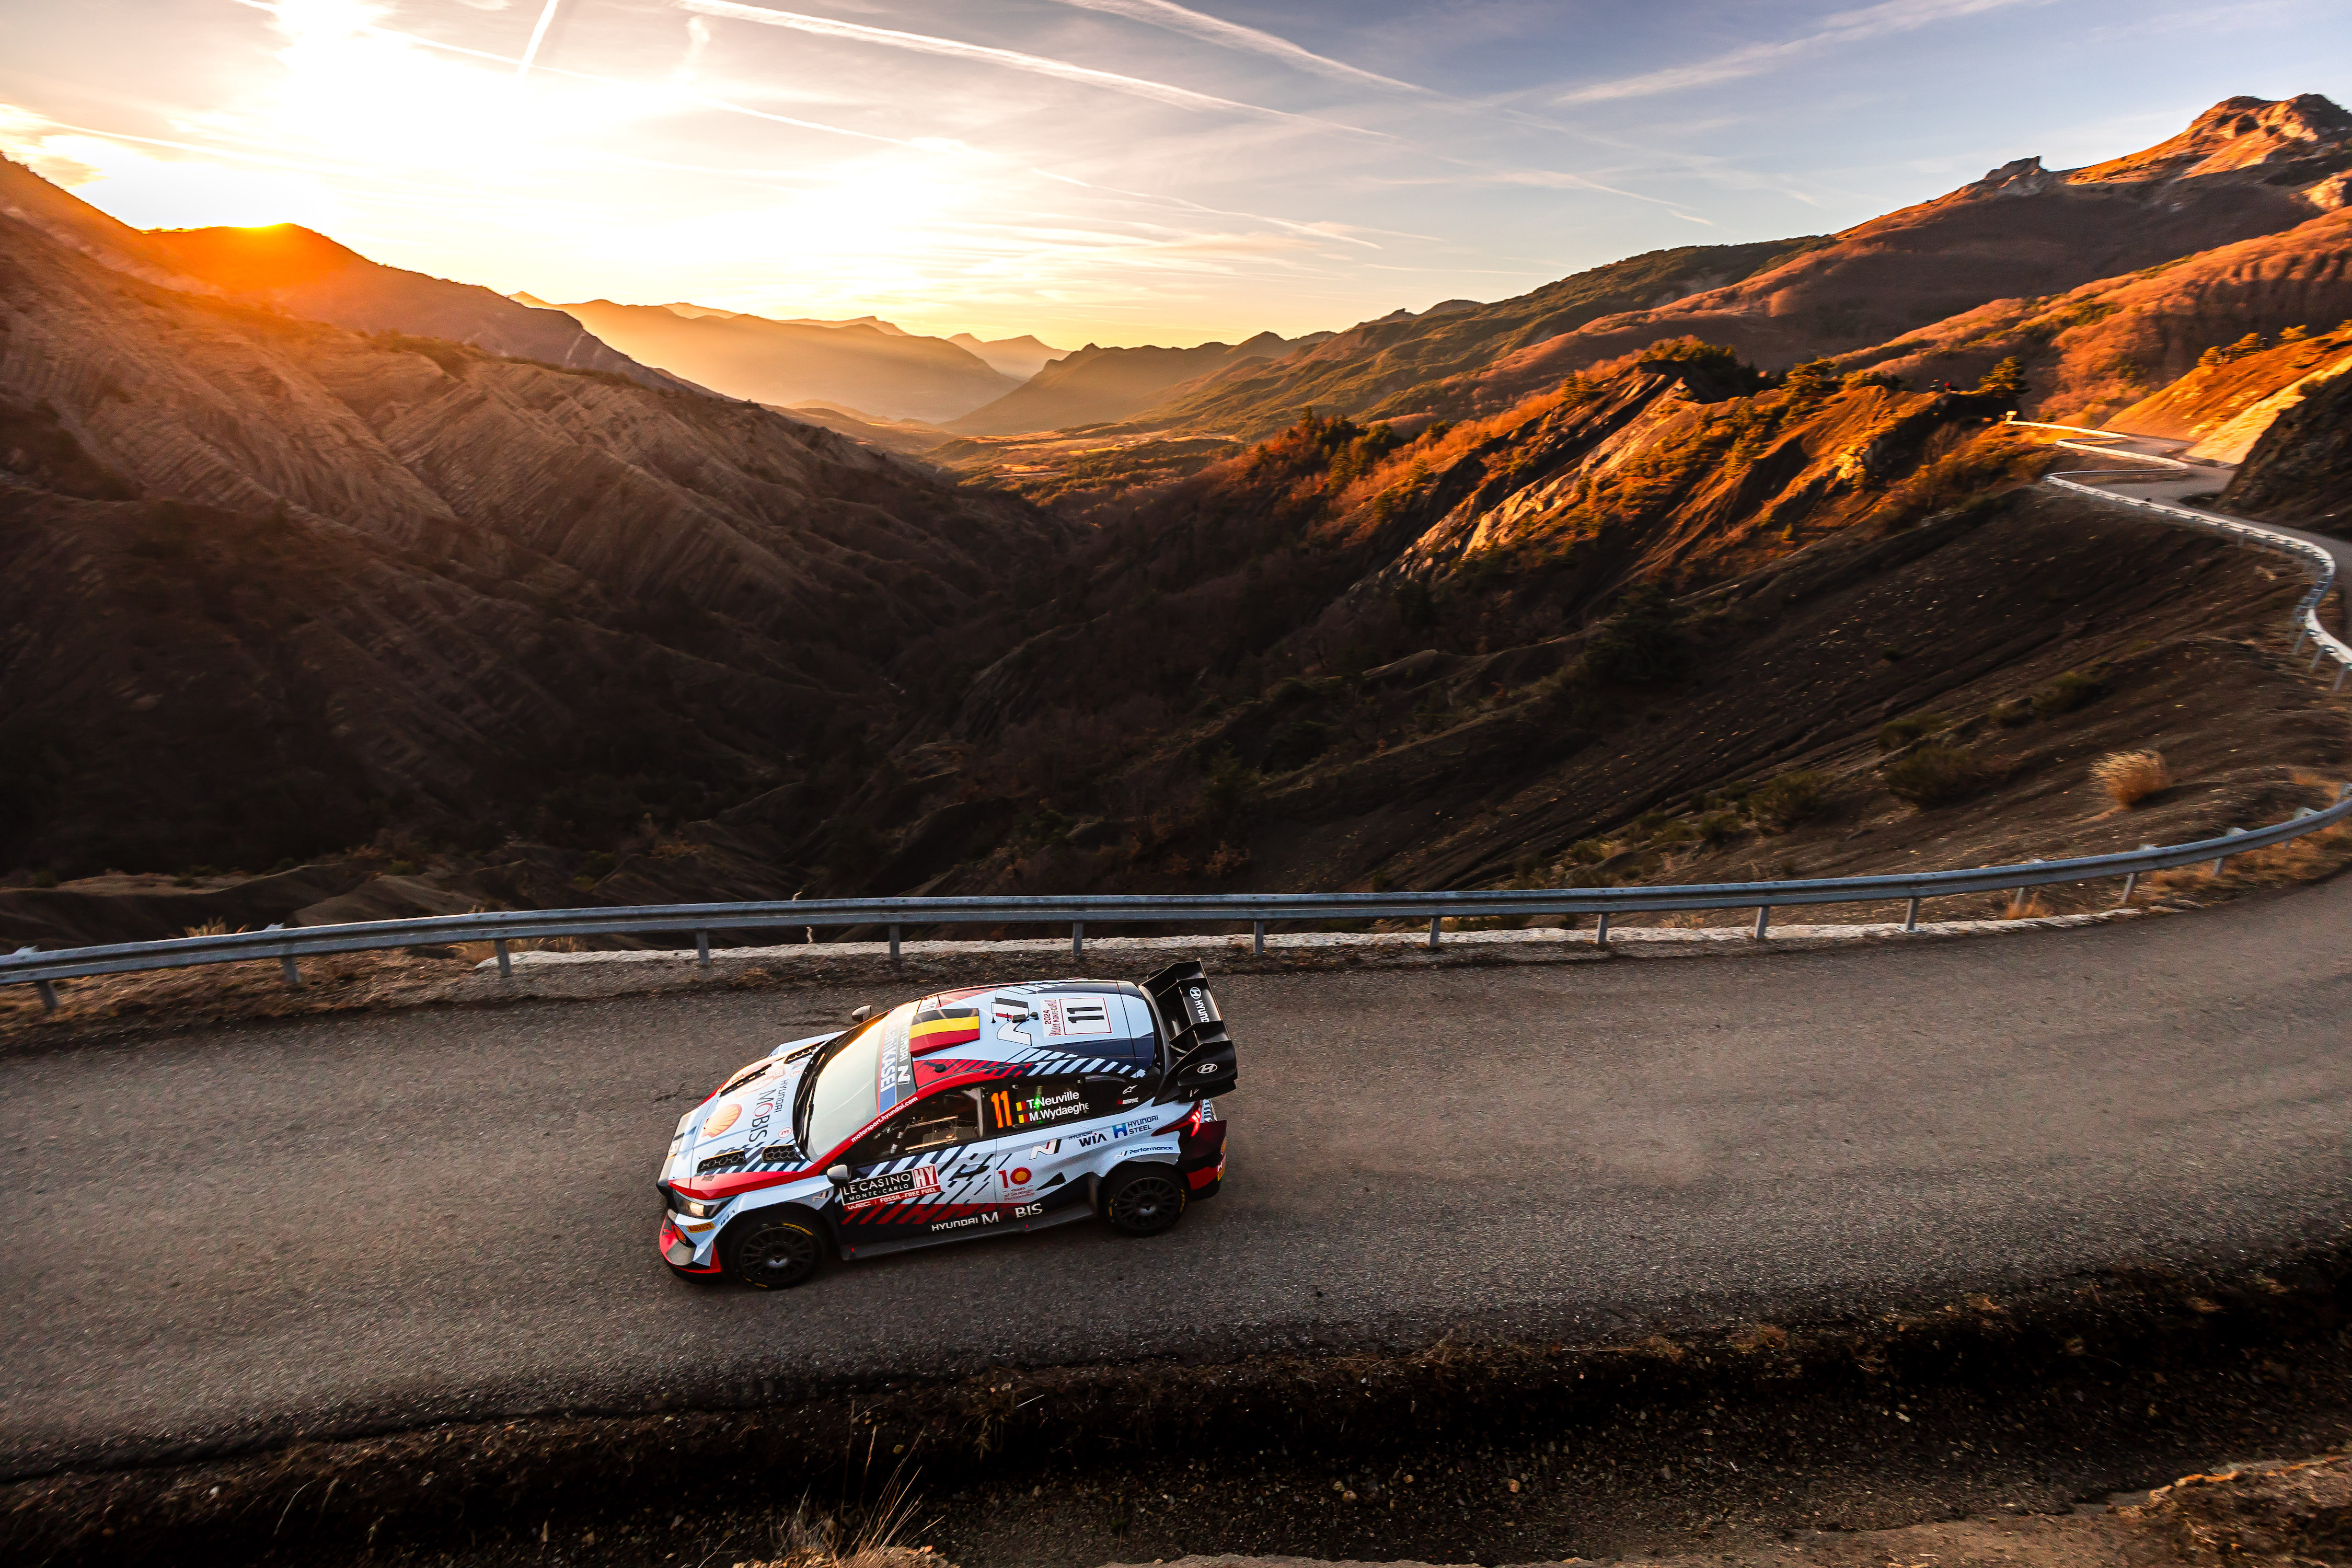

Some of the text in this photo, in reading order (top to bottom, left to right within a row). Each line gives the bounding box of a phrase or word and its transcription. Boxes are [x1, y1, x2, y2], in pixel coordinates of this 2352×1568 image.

[1043, 1010, 1052, 1024] 2024
[1066, 1006, 1105, 1024] 11
[1194, 999, 1210, 1023] HYUND
[1048, 1023, 1062, 1036] RALLYE
[774, 1079, 789, 1113] HYUNDAI
[1026, 1091, 1080, 1109] T.Neuville
[748, 1089, 777, 1143] MOBIS
[990, 1090, 1013, 1128] 11
[851, 1097, 918, 1143] motorsport.hyundai.com
[1127, 1114, 1159, 1128] HYUNDAI
[1068, 1131, 1093, 1140] HYUNDAI
[1128, 1125, 1152, 1135] STEEL
[1129, 1146, 1173, 1155] Performance
[843, 1173, 911, 1195] LE CASINO
[914, 1166, 935, 1189] HY
[880, 1190, 920, 1203] FOSSIL-FREE
[931, 1217, 978, 1231] HYUNDAI
